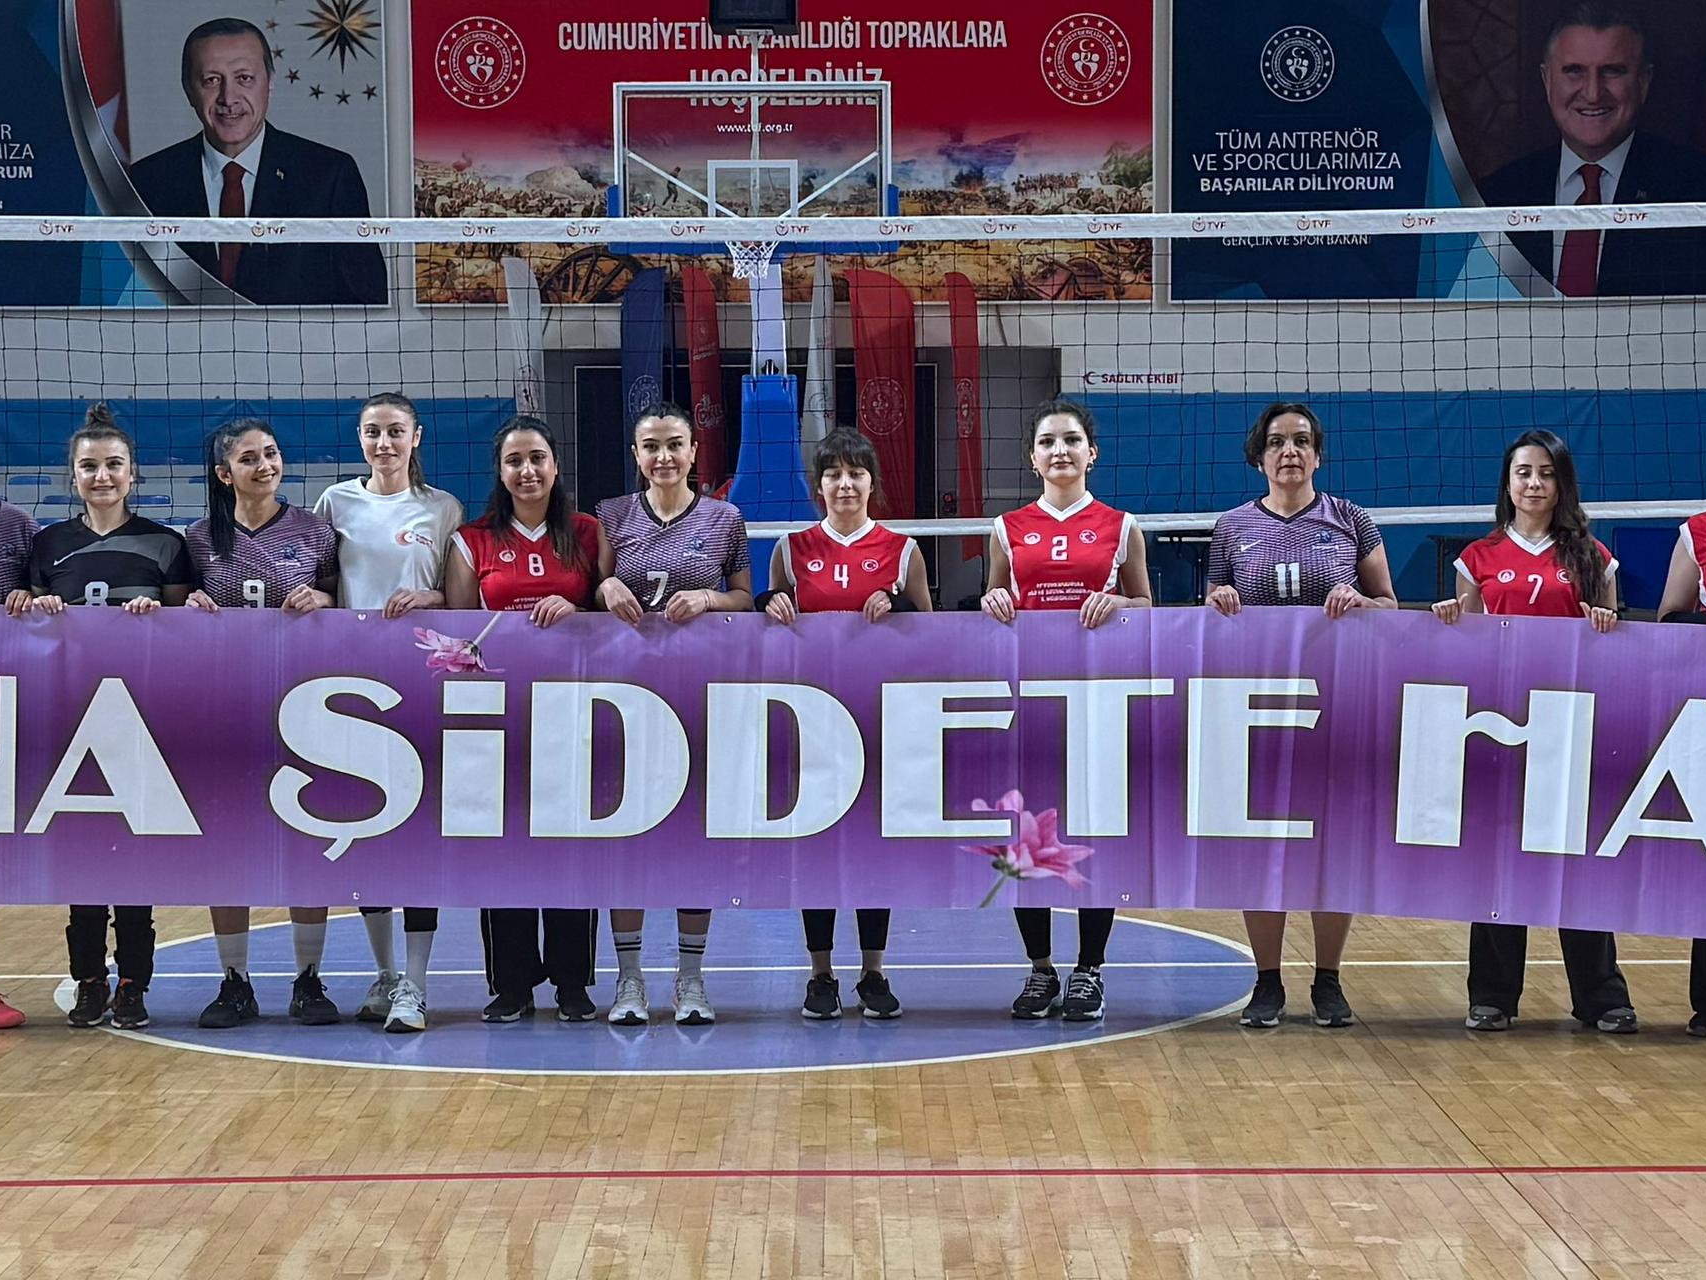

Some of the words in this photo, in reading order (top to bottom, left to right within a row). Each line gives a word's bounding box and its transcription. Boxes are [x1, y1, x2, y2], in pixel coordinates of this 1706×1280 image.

[558, 17, 722, 51] CUMHURİYETİN
[866, 20, 1007, 49] TOPRAKLARA
[1215, 129, 1261, 149] TÜM
[1267, 128, 1378, 148] ANTRENÖR
[1193, 154, 1217, 170] VE
[1223, 152, 1401, 170] SPORCULARIMIZA
[1200, 177, 1294, 195] BAŞARILAR
[1299, 174, 1394, 190] DİLİYORUM
[1101, 373, 1143, 384] SAĞLIK
[1147, 372, 1178, 384] EKİBİ
[1051, 535, 1068, 561] 2
[528, 553, 545, 577] 8
[833, 564, 850, 589] 4
[647, 572, 669, 607] 7
[1274, 562, 1301, 598] 11
[1527, 574, 1544, 605] 7
[84, 581, 109, 606] 8
[242, 579, 266, 609] 9
[267, 675, 1321, 861] ŞİDDETE
